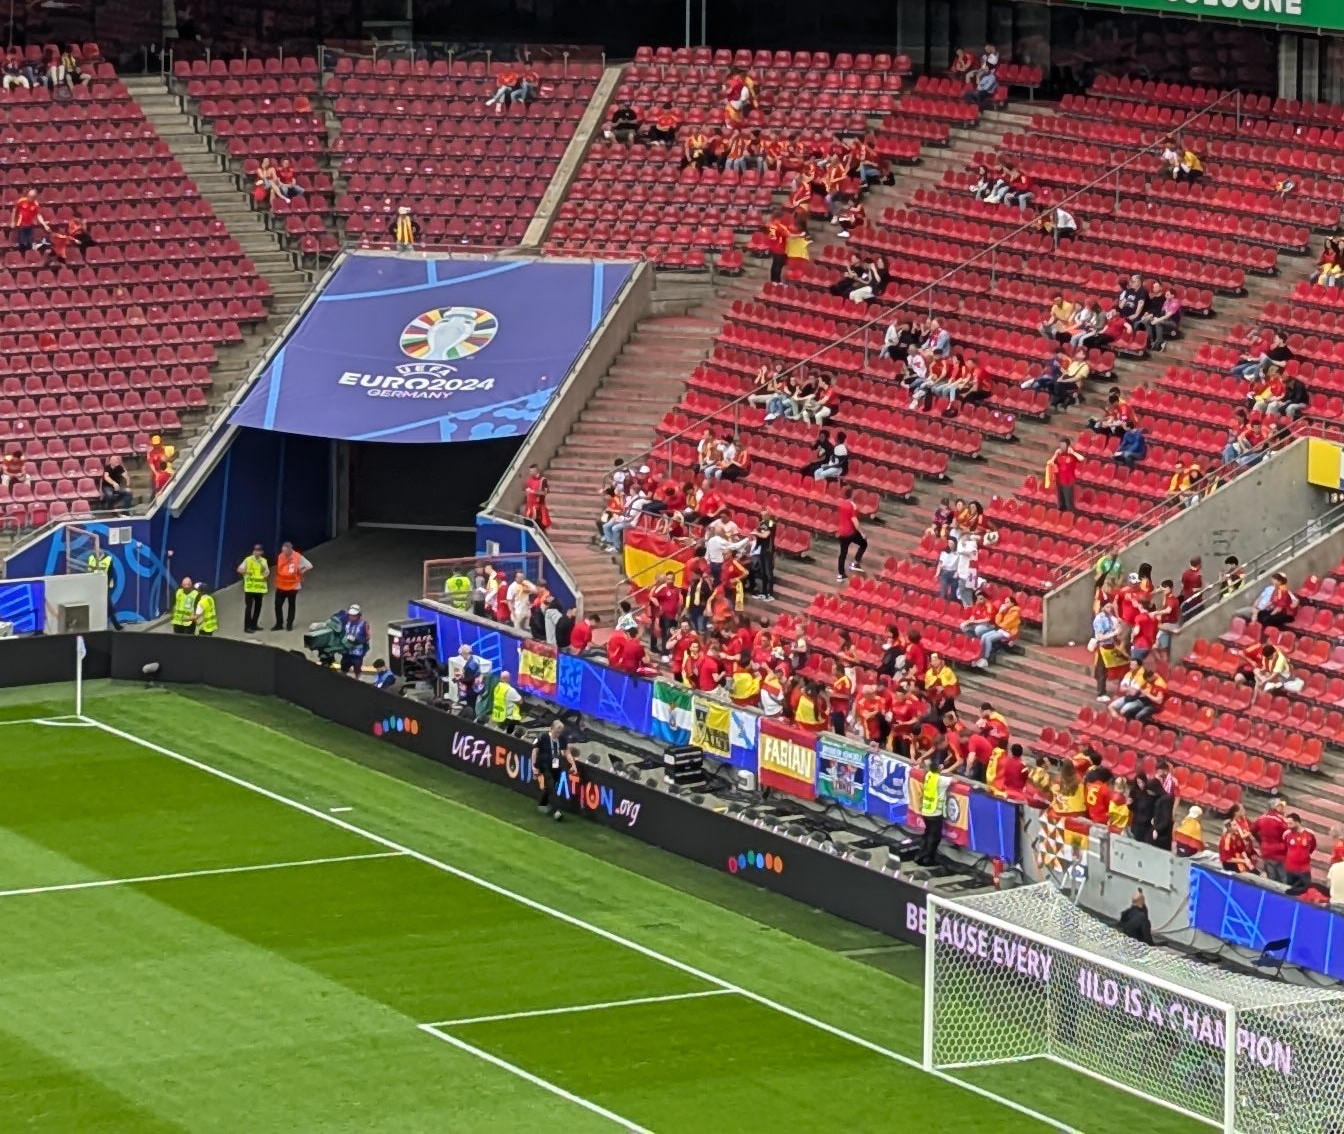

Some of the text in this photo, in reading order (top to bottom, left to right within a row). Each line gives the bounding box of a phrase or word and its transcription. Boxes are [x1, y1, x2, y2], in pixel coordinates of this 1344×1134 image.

[397, 364, 452, 377] UEFA
[367, 388, 454, 399] GERMANY
[451, 730, 492, 768] UEFA
[992, 934, 1053, 982] EVERY
[1124, 984, 1144, 1018] IS
